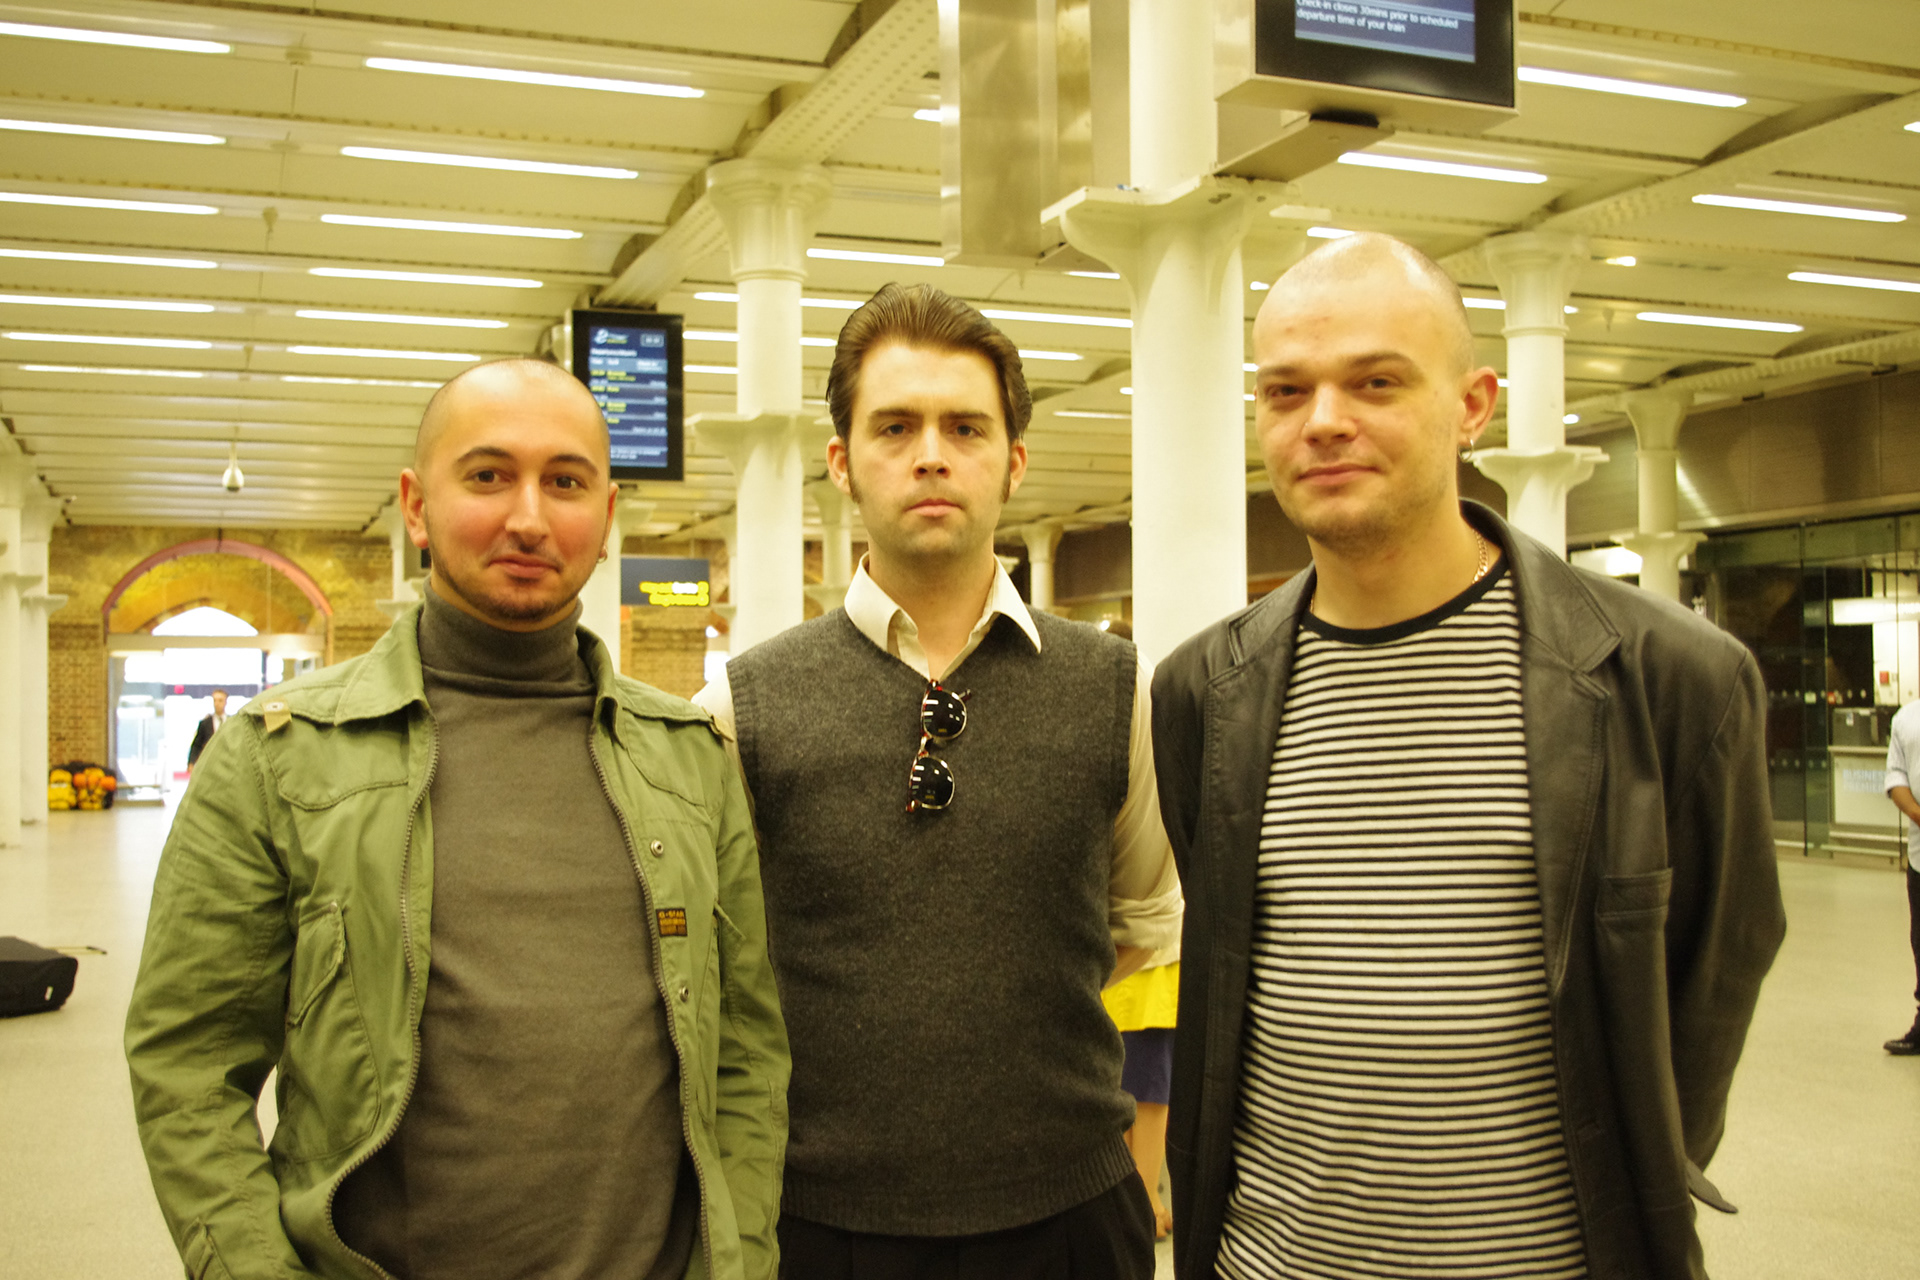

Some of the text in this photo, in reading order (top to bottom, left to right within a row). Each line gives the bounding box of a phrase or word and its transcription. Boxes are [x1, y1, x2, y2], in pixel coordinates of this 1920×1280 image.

[1296, 0, 1459, 29] Check-in closes 30mins prior to scheduled
[1296, 8, 1406, 33] departure time of your train
